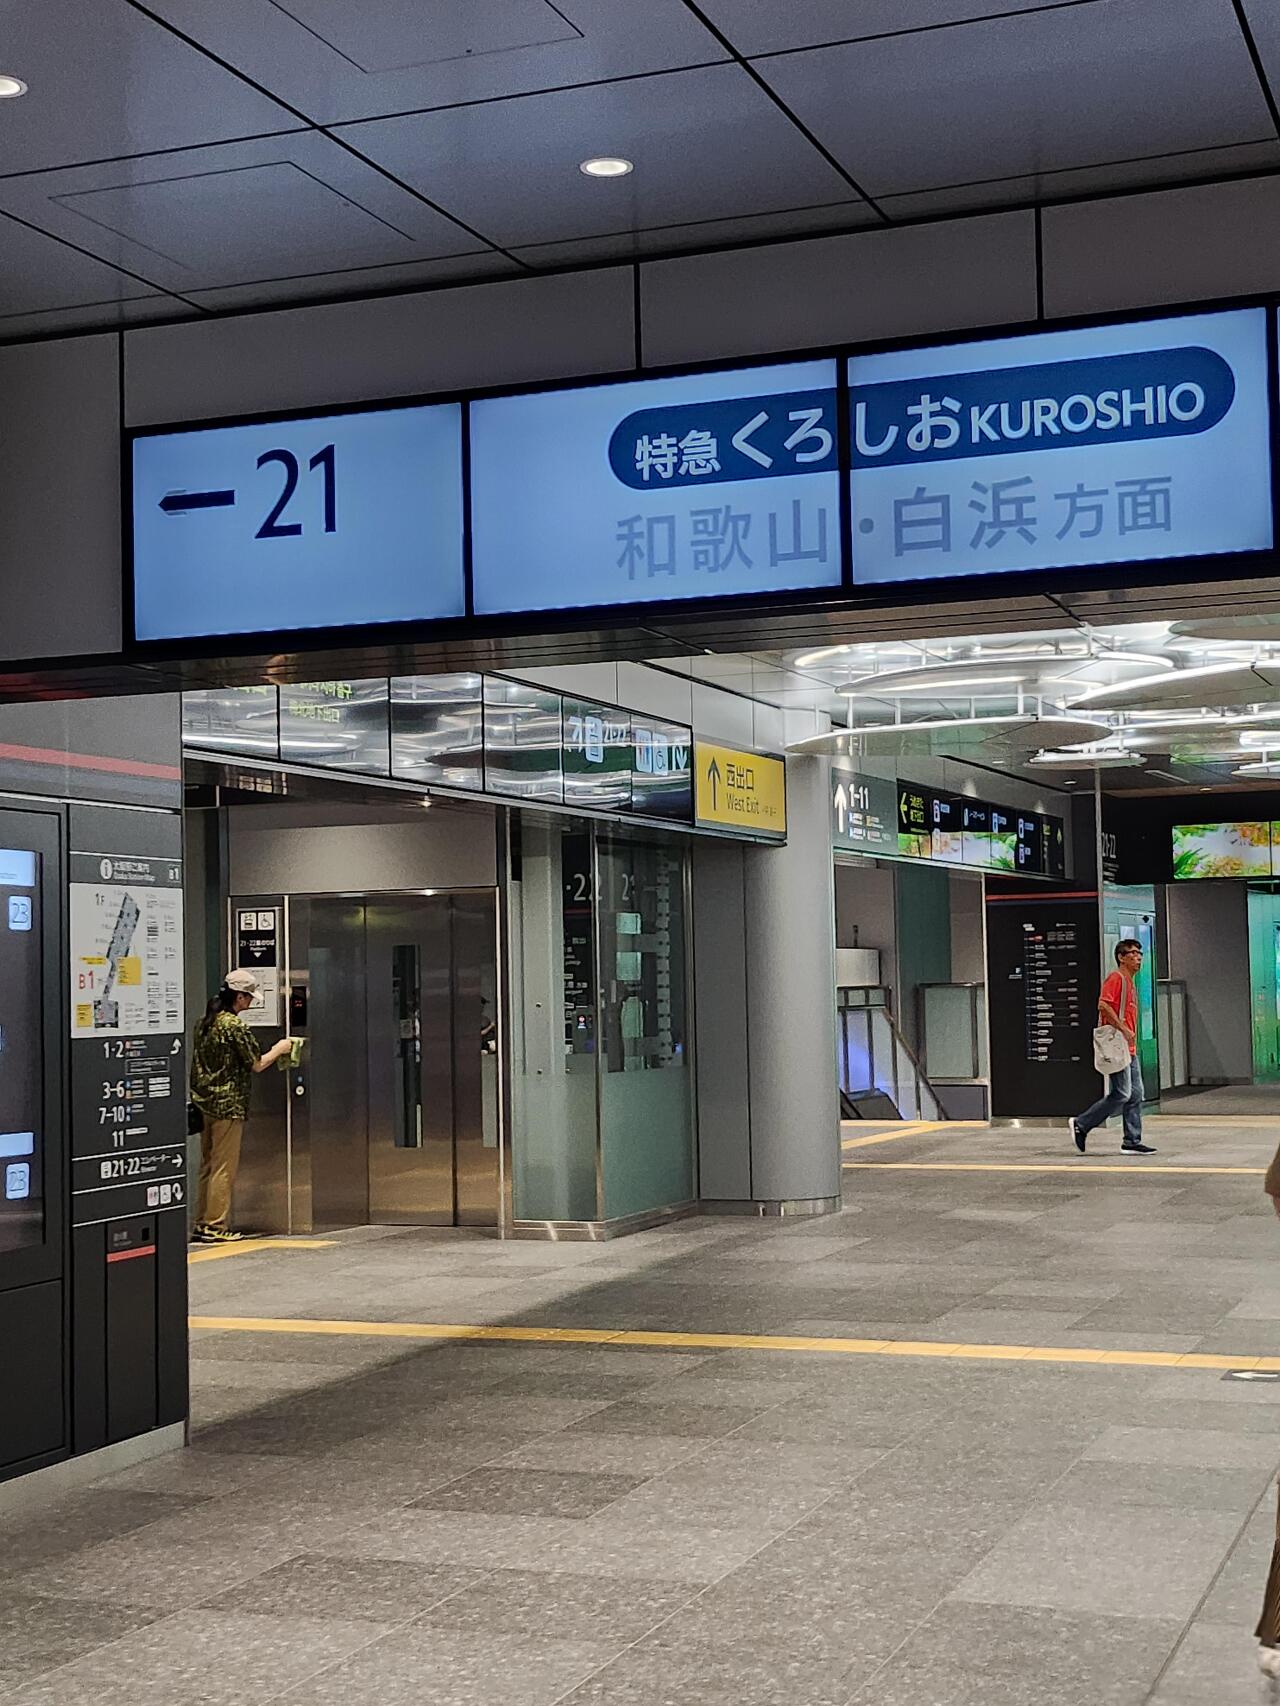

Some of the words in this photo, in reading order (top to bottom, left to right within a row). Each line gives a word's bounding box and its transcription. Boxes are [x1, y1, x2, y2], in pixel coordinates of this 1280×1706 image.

[970, 381, 1205, 444] KUROSHIO
[254, 443, 337, 539] 21
[615, 475, 1173, 581] 和歌山・白浜方面
[726, 763, 754, 791] 西出口
[79, 970, 94, 990] B1
[112, 1130, 125, 1148] 11
